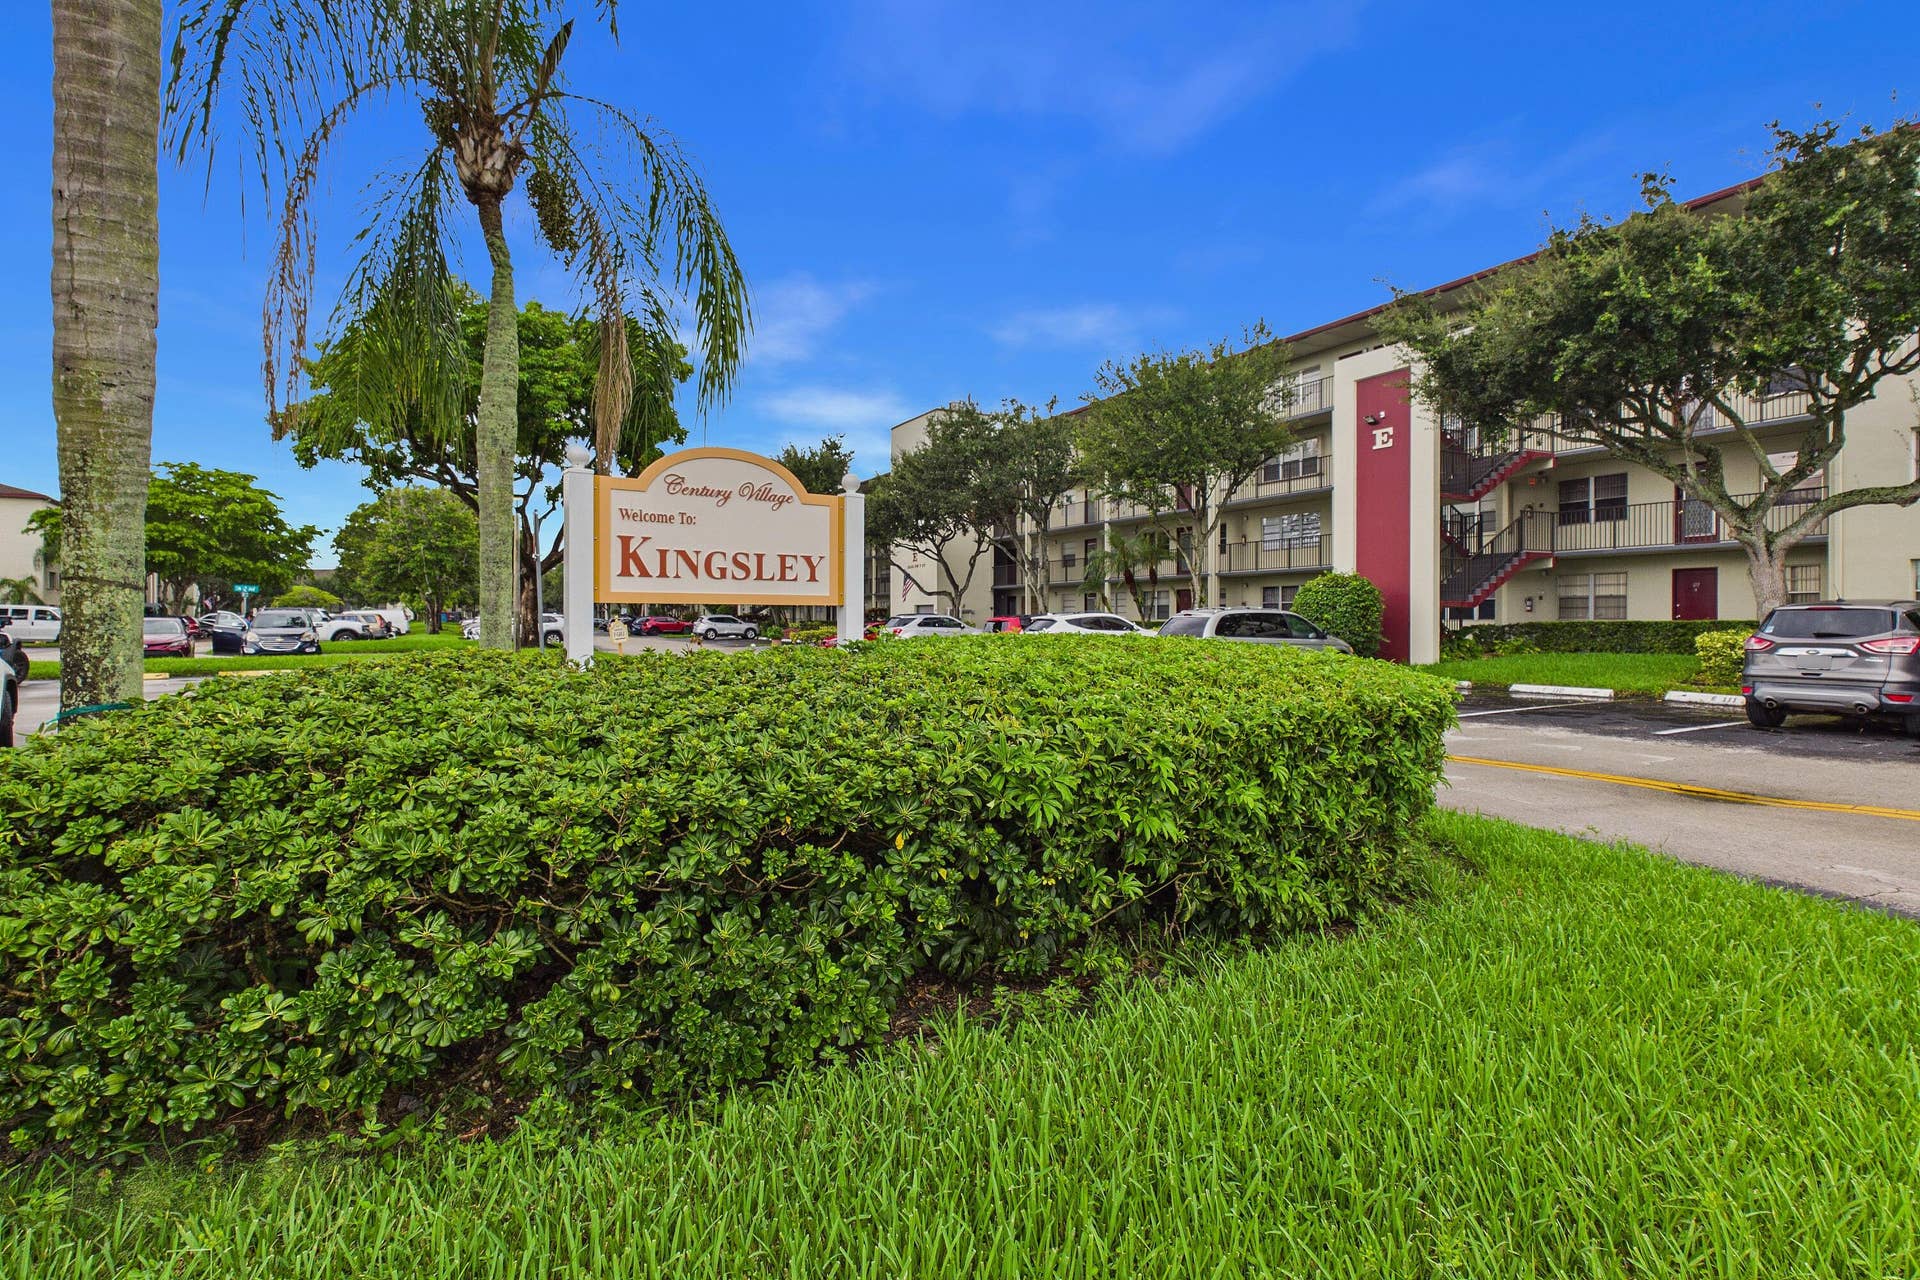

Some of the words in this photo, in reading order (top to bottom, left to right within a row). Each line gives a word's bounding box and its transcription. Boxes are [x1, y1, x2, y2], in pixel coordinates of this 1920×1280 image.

[1372, 427, 1393, 449] E
[663, 473, 733, 508] Century
[738, 481, 794, 512] Village
[618, 507, 676, 525] Welcome
[678, 511, 697, 526] To:
[616, 534, 826, 583] KINGSLEY
